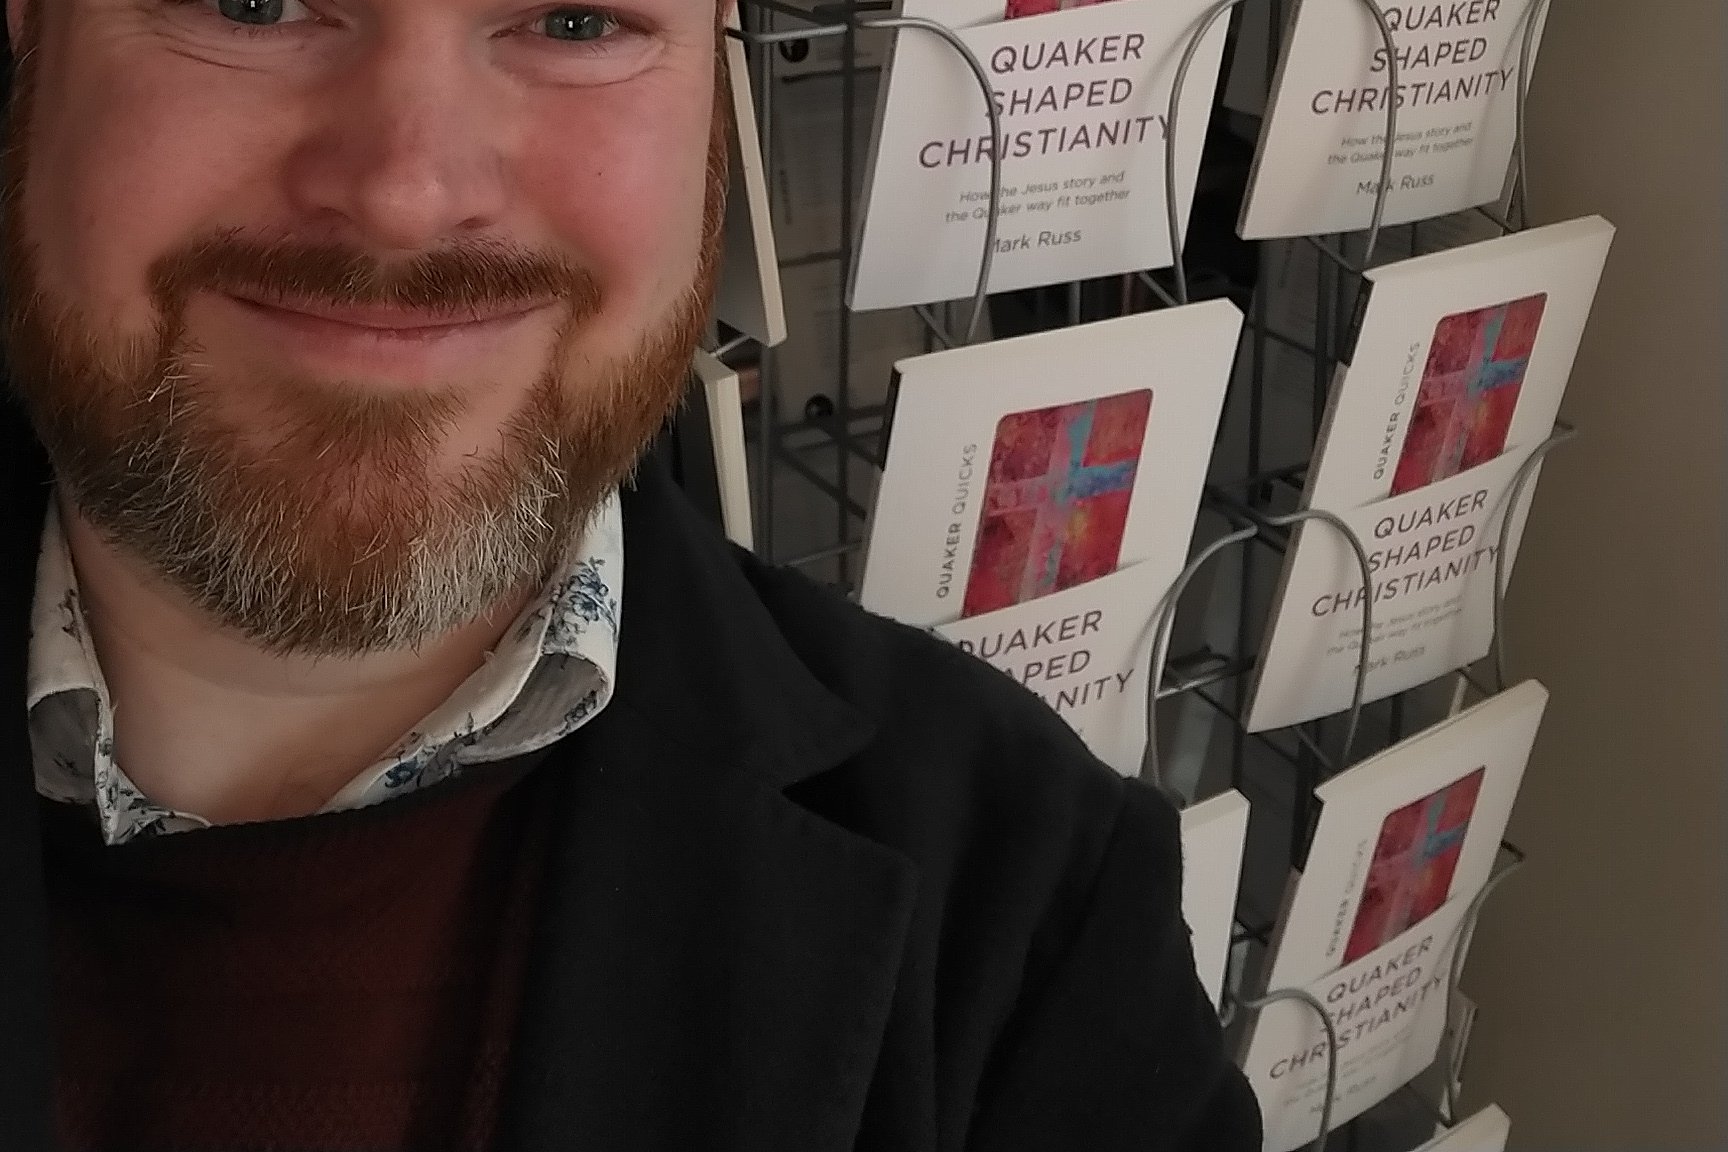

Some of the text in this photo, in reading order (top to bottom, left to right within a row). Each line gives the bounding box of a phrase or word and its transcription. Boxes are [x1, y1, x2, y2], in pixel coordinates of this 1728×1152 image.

[989, 32, 1146, 75] QUAKER
[1369, 36, 1488, 73] SHAPED
[984, 77, 1133, 119] SHAPED
[1310, 67, 1515, 115] CHRISTIANITY
[944, 209, 969, 224] the
[972, 203, 1022, 221] Quker
[1026, 199, 1052, 213] way
[1074, 188, 1131, 207] together
[999, 185, 1018, 198] he
[1021, 182, 1058, 196] Jesus
[1062, 175, 1096, 192] story
[1099, 170, 1126, 185] and
[1037, 228, 1083, 248] Russ
[1372, 411, 1399, 481] QUAKER
[1373, 488, 1489, 540] QUAKER
[936, 521, 962, 599] QUAKER
[1367, 524, 1476, 574] SHAPED
[1325, 934, 1434, 1004] QUAKER
[1269, 975, 1443, 1081] CHRSTIANITY
